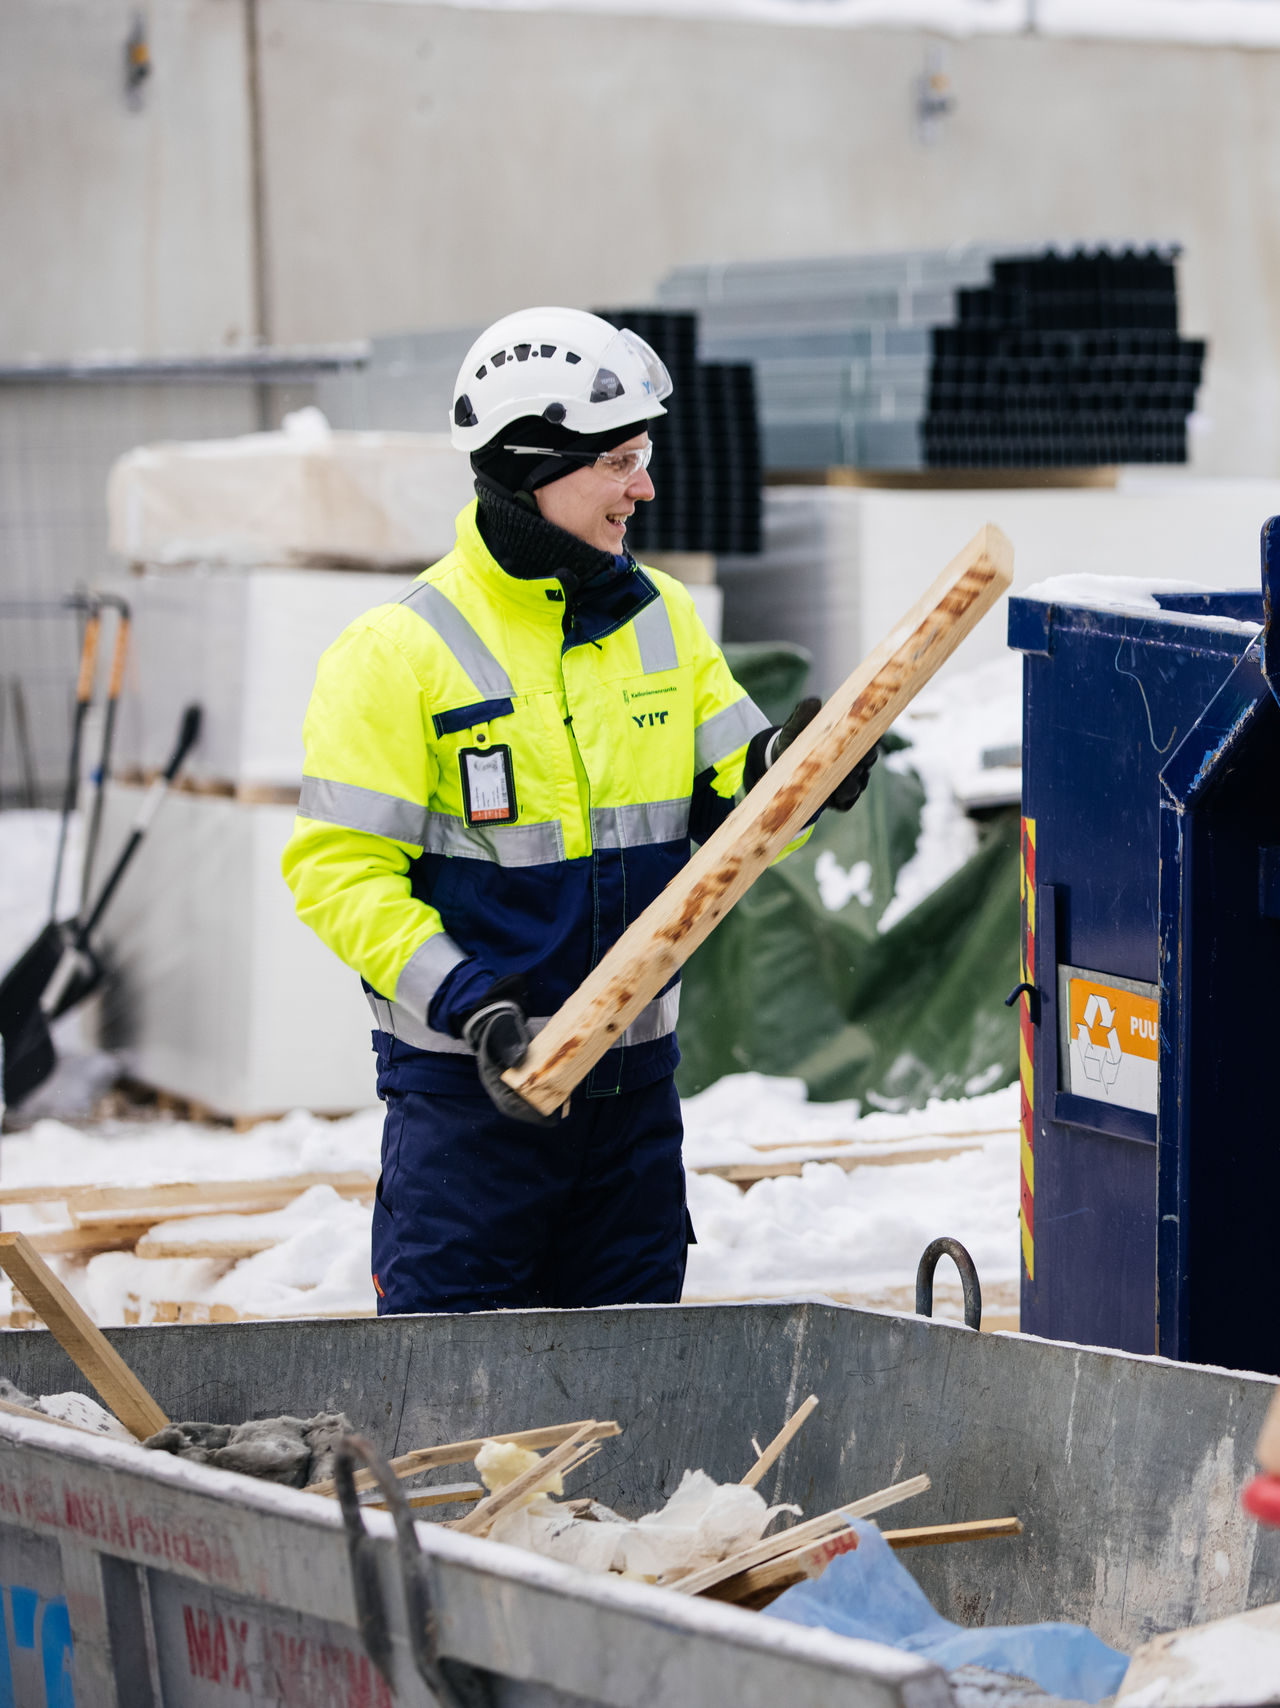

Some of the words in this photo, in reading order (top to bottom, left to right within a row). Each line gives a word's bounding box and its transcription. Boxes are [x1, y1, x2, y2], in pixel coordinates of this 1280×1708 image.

[632, 710, 669, 728] YIT
[1130, 1015, 1158, 1041] PUU
[182, 1604, 252, 1692] MAX
